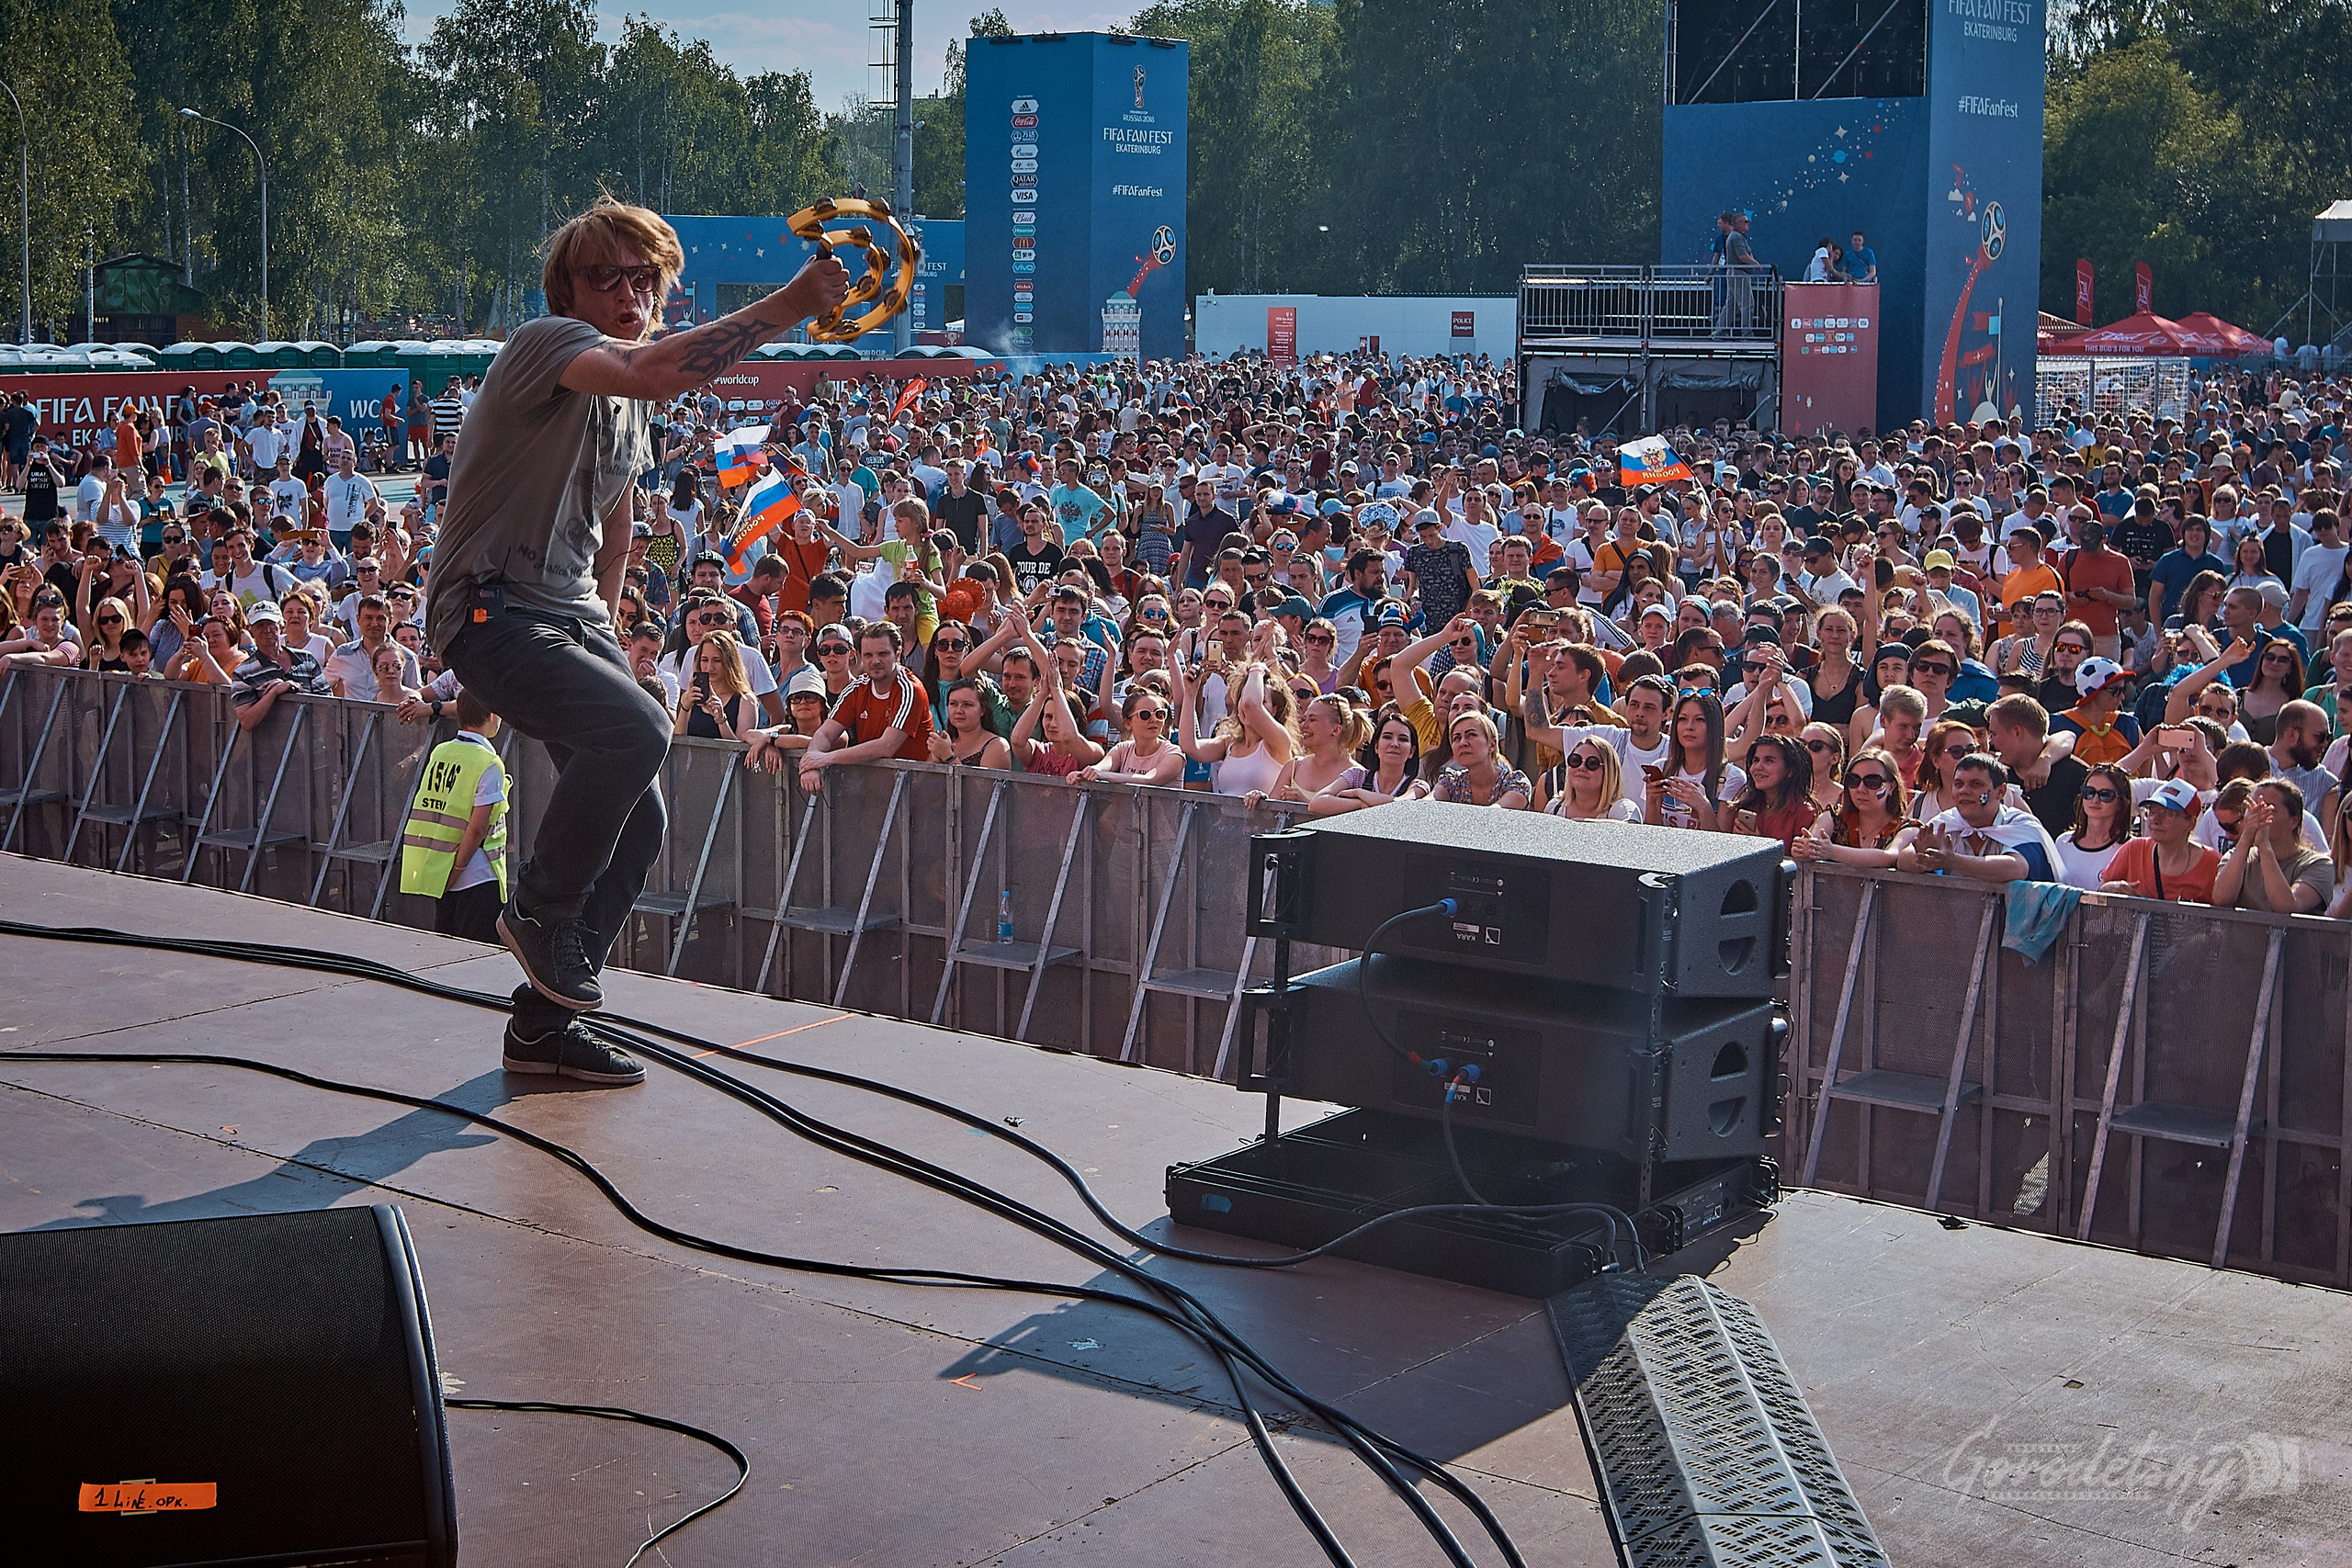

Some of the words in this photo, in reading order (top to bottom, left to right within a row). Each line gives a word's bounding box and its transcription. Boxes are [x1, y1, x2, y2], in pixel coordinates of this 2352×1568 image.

[1977, 0, 2001, 20] FAN
[2004, 1, 2032, 25] FEST
[1964, 21, 2018, 42] EKATERINBURG
[1958, 96, 2018, 118] #FIFAFanFest
[1123, 114, 1143, 122] RUSSIA
[1143, 115, 1155, 123] 2018
[1103, 128, 1125, 141] FIFA
[1126, 129, 1148, 142] FAN
[1148, 130, 1173, 144] FEST
[1115, 143, 1161, 154] EKATERINBURG
[1013, 175, 1035, 183] QATAR
[1015, 191, 1034, 200] VISA
[1112, 185, 1163, 197] #FIFAFanFest
[1016, 213, 1033, 222] Bud
[927, 262, 947, 270] FEST
[1014, 263, 1033, 271] vivo
[2079, 280, 2088, 304] Bud
[2138, 284, 2148, 307] Bud
[713, 374, 760, 386] #worldcup
[37, 397, 96, 424] FIFA
[350, 399, 380, 419] WC
[1017, 561, 1037, 574] TOUR
[1038, 561, 1051, 574] DE
[1456, 931, 1476, 942] KARA
[94, 1486, 108, 1507] 1
